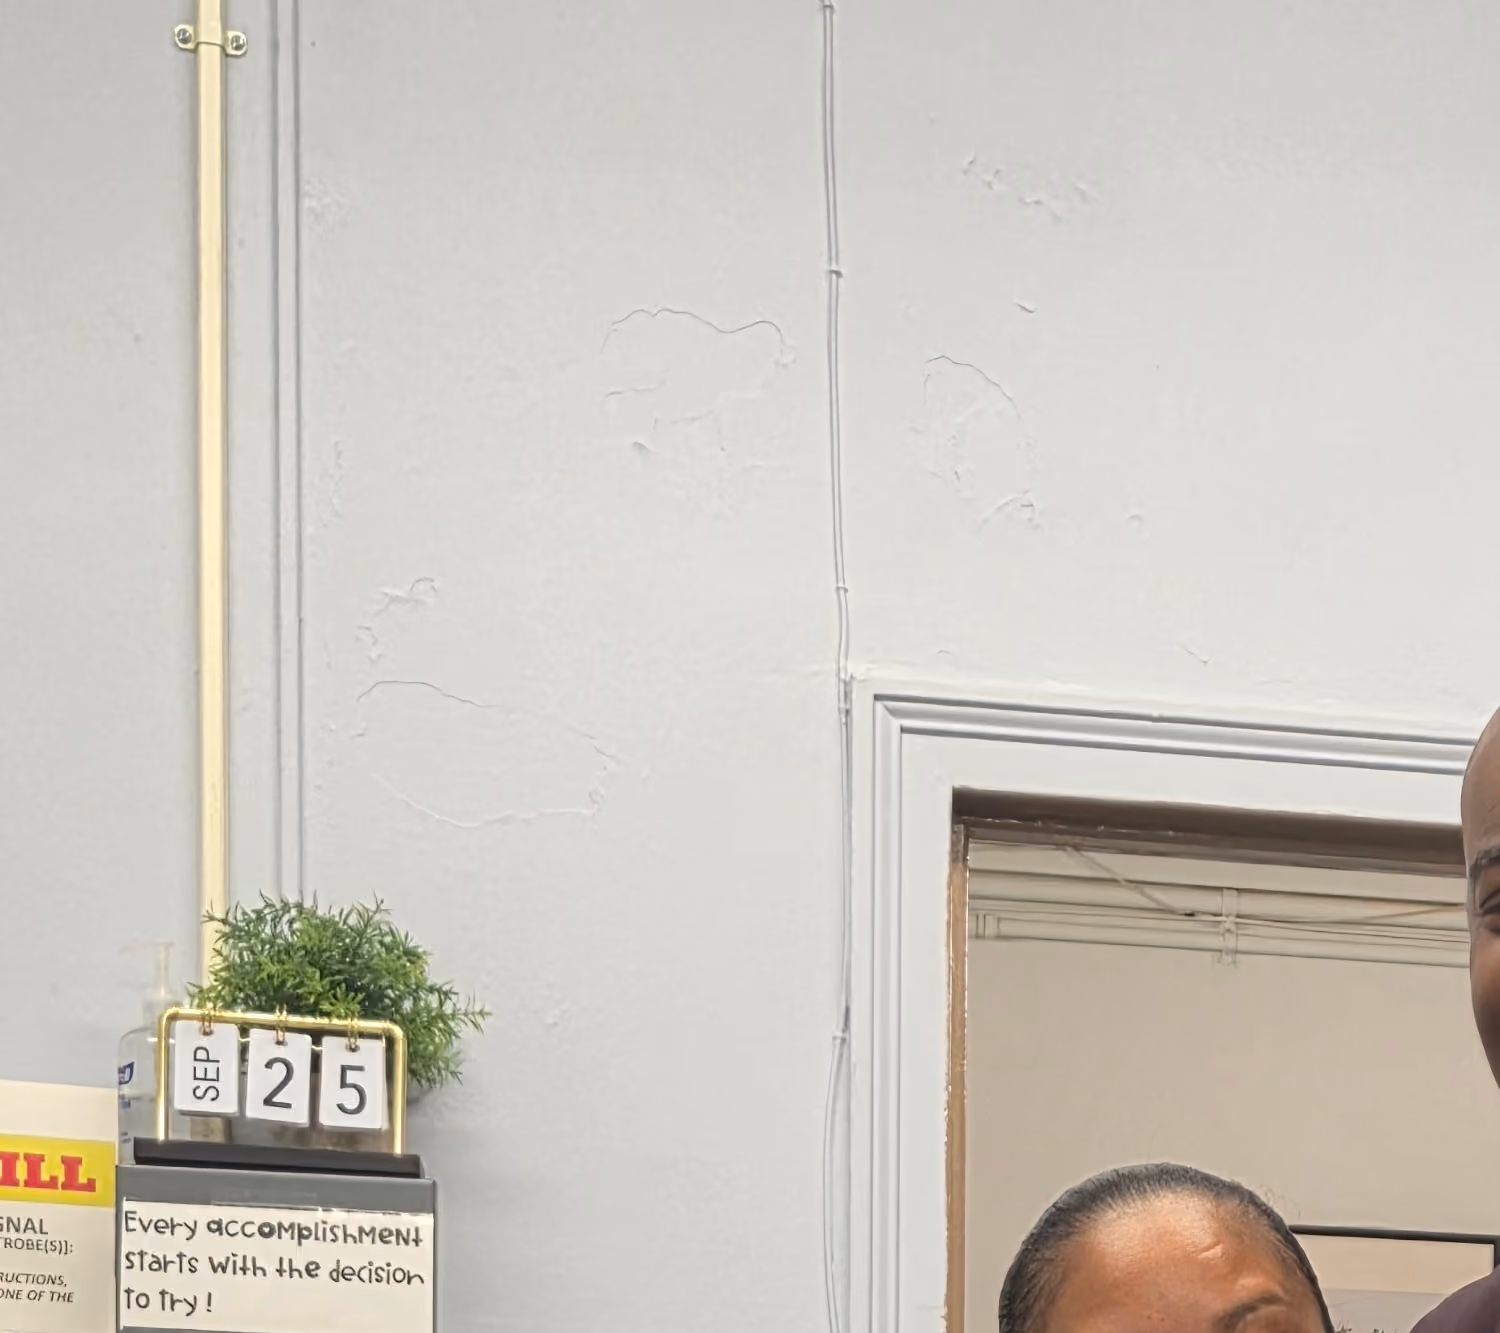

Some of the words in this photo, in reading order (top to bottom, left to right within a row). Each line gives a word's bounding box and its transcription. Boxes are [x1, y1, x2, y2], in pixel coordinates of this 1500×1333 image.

[193, 1046, 220, 1101] SEP
[263, 1057, 294, 1109] 2
[336, 1065, 367, 1115] 5
[125, 1211, 197, 1240] Every
[125, 1250, 198, 1274] starts
[208, 1253, 267, 1277] with
[276, 1257, 321, 1279] the
[329, 1259, 424, 1285] decision
[27, 1289, 46, 1302] OF
[50, 1290, 74, 1303] THE
[125, 1287, 150, 1310] to
